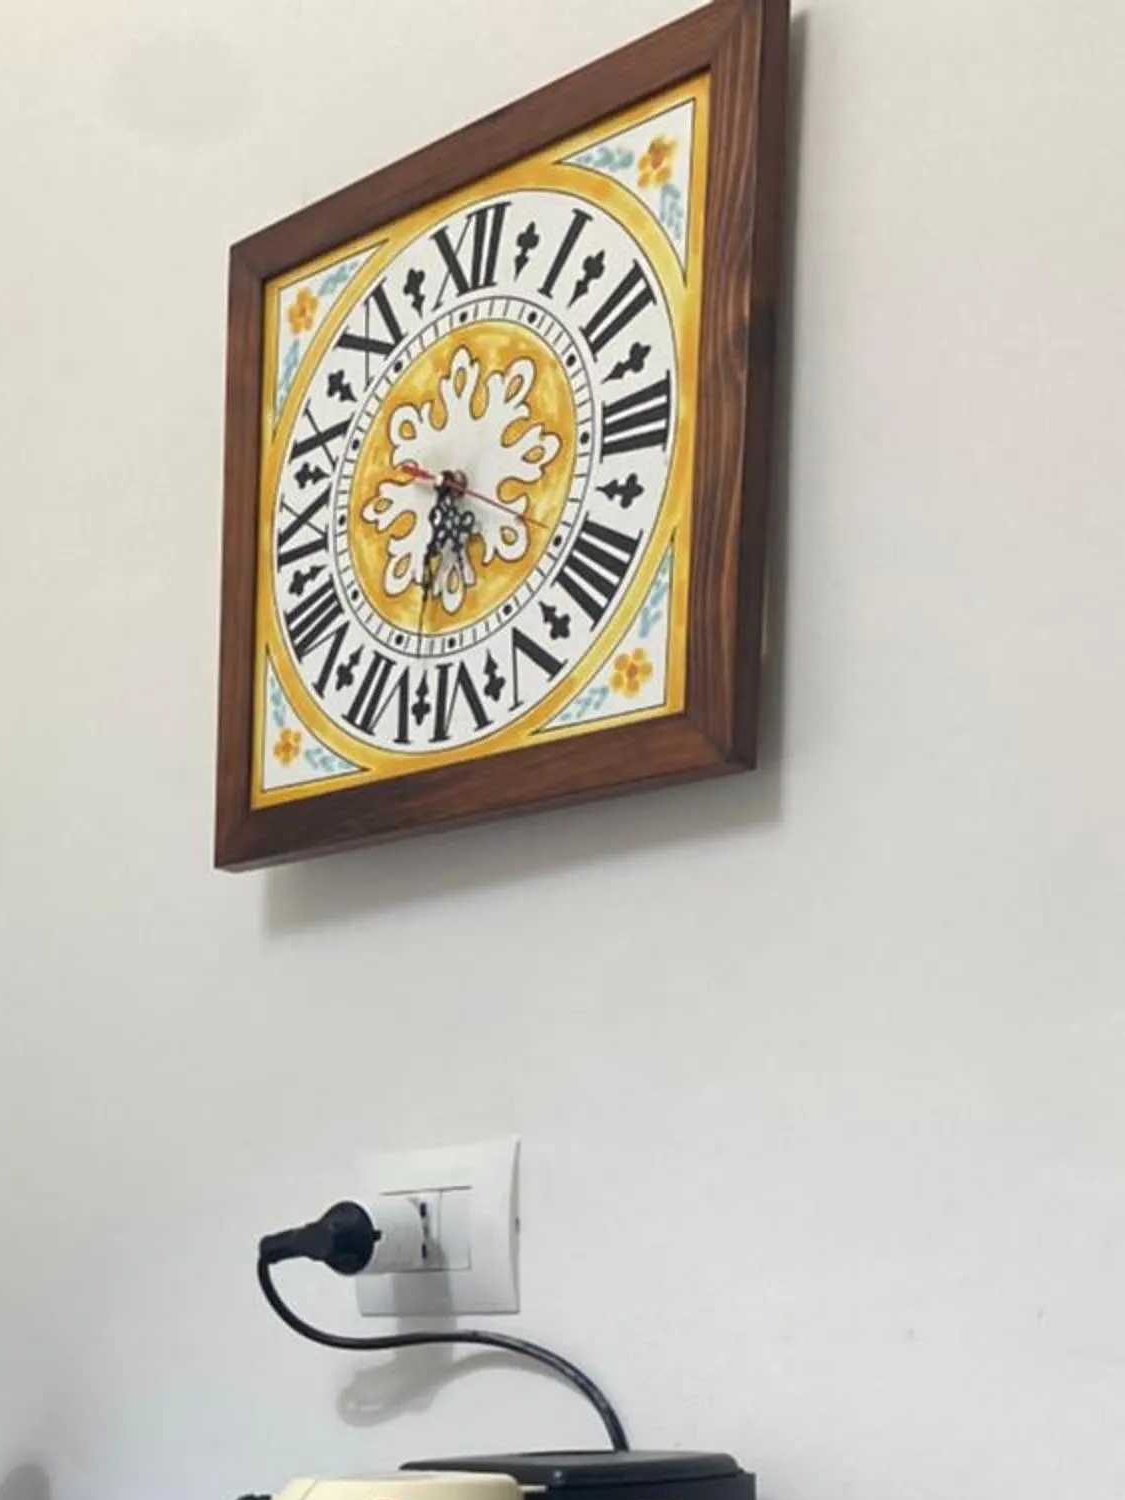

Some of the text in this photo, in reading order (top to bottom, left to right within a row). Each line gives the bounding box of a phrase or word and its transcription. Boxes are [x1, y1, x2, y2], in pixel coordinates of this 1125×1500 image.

[431, 202, 512, 308] XII
[538, 209, 593, 299] I
[335, 279, 406, 384] XI
[580, 260, 657, 362] II
[290, 406, 353, 470] X
[600, 370, 672, 462] III
[277, 487, 331, 567] IX
[551, 513, 644, 630] IIII
[284, 576, 349, 699] VIII
[508, 627, 567, 712] V
[342, 656, 411, 745] VII
[428, 662, 493, 743] VI
